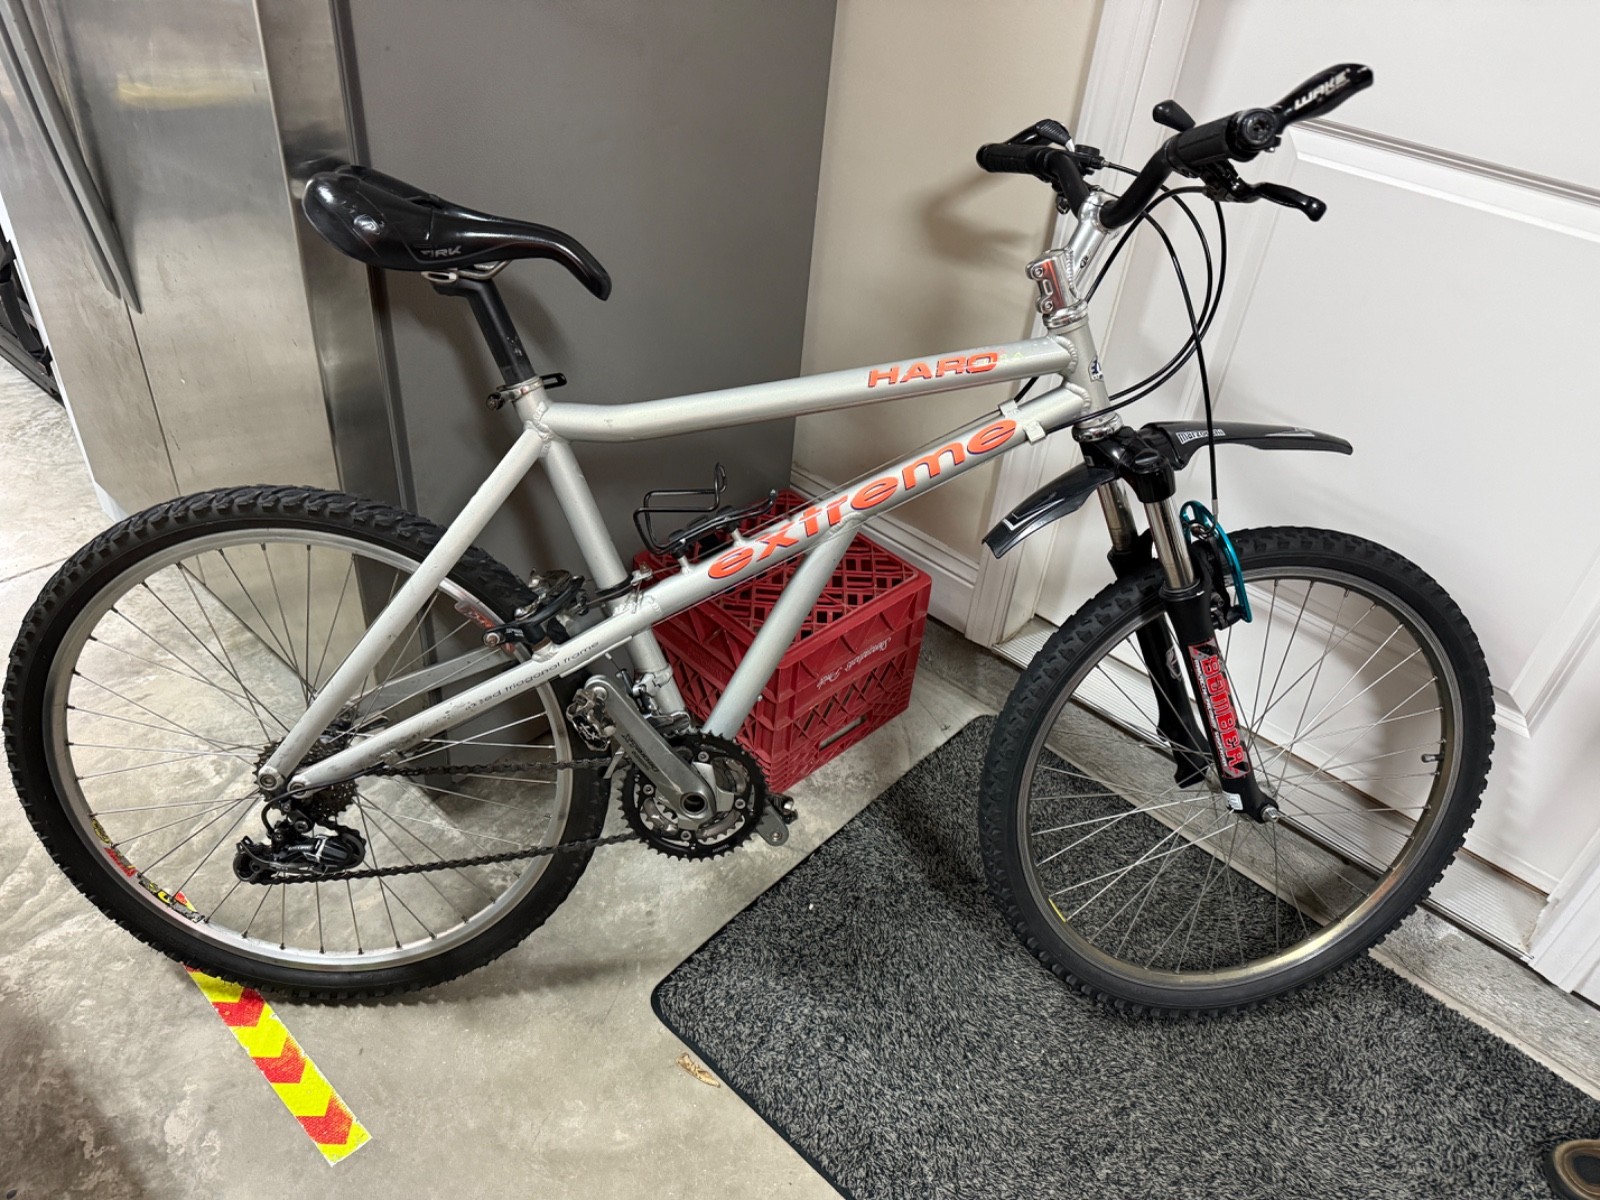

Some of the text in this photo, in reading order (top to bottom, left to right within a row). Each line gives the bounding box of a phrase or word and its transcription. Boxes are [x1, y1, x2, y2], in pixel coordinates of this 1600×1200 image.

[867, 352, 998, 388] HARO
[707, 419, 1017, 579] extreme
[505, 641, 599, 692] triagonal frame
